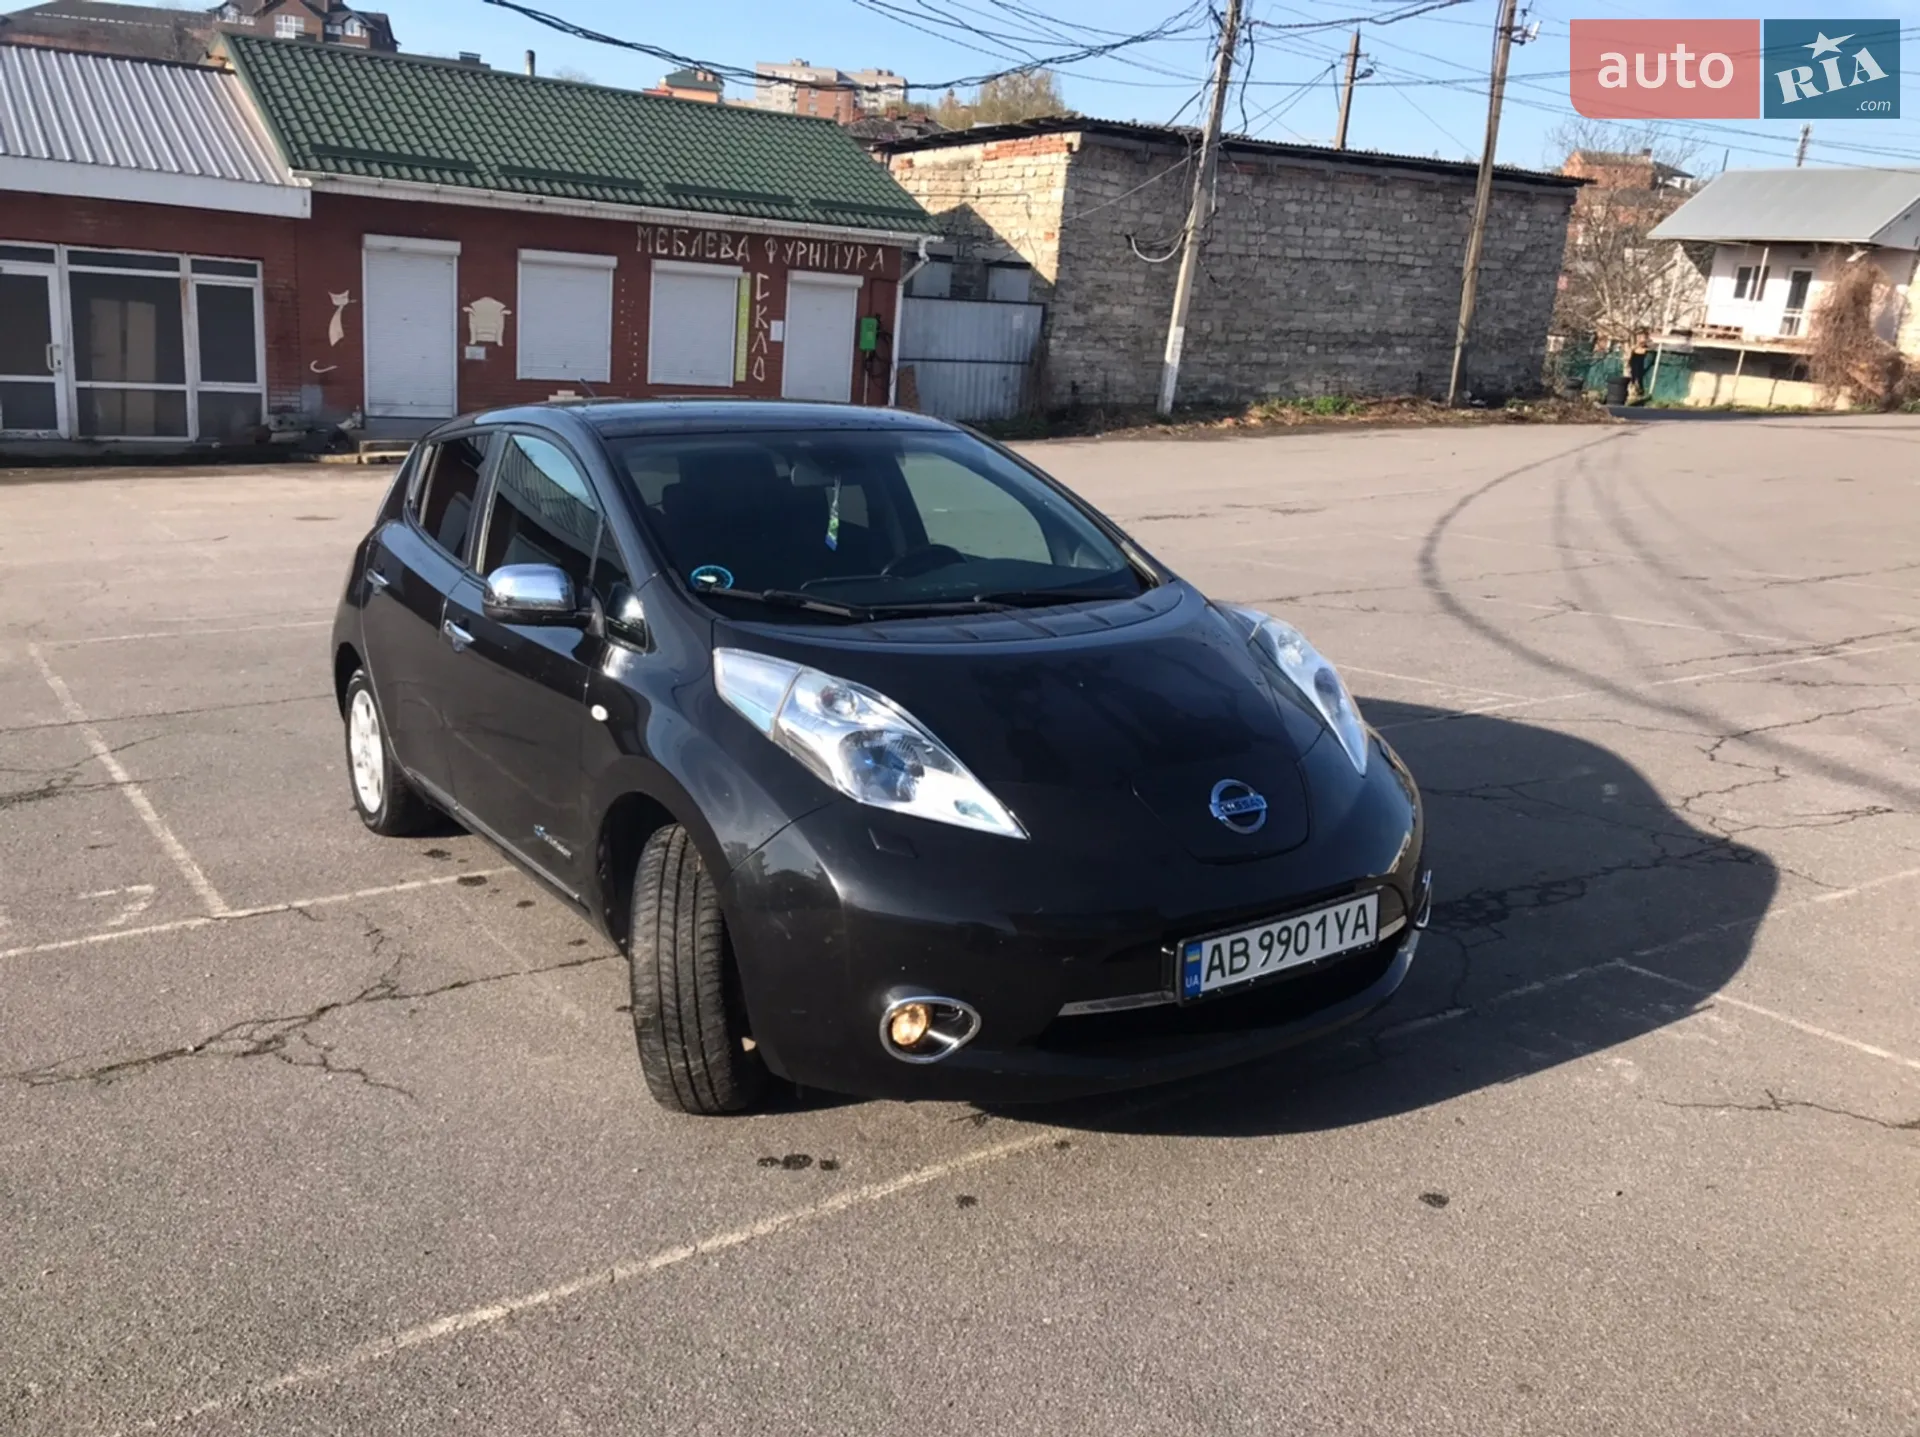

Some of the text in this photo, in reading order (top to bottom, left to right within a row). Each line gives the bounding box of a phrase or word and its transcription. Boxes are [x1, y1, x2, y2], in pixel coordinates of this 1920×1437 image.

[636, 225, 884, 271] МЕБЛЕВА ФУРНІТУРА
[1185, 975, 1199, 989] UA
